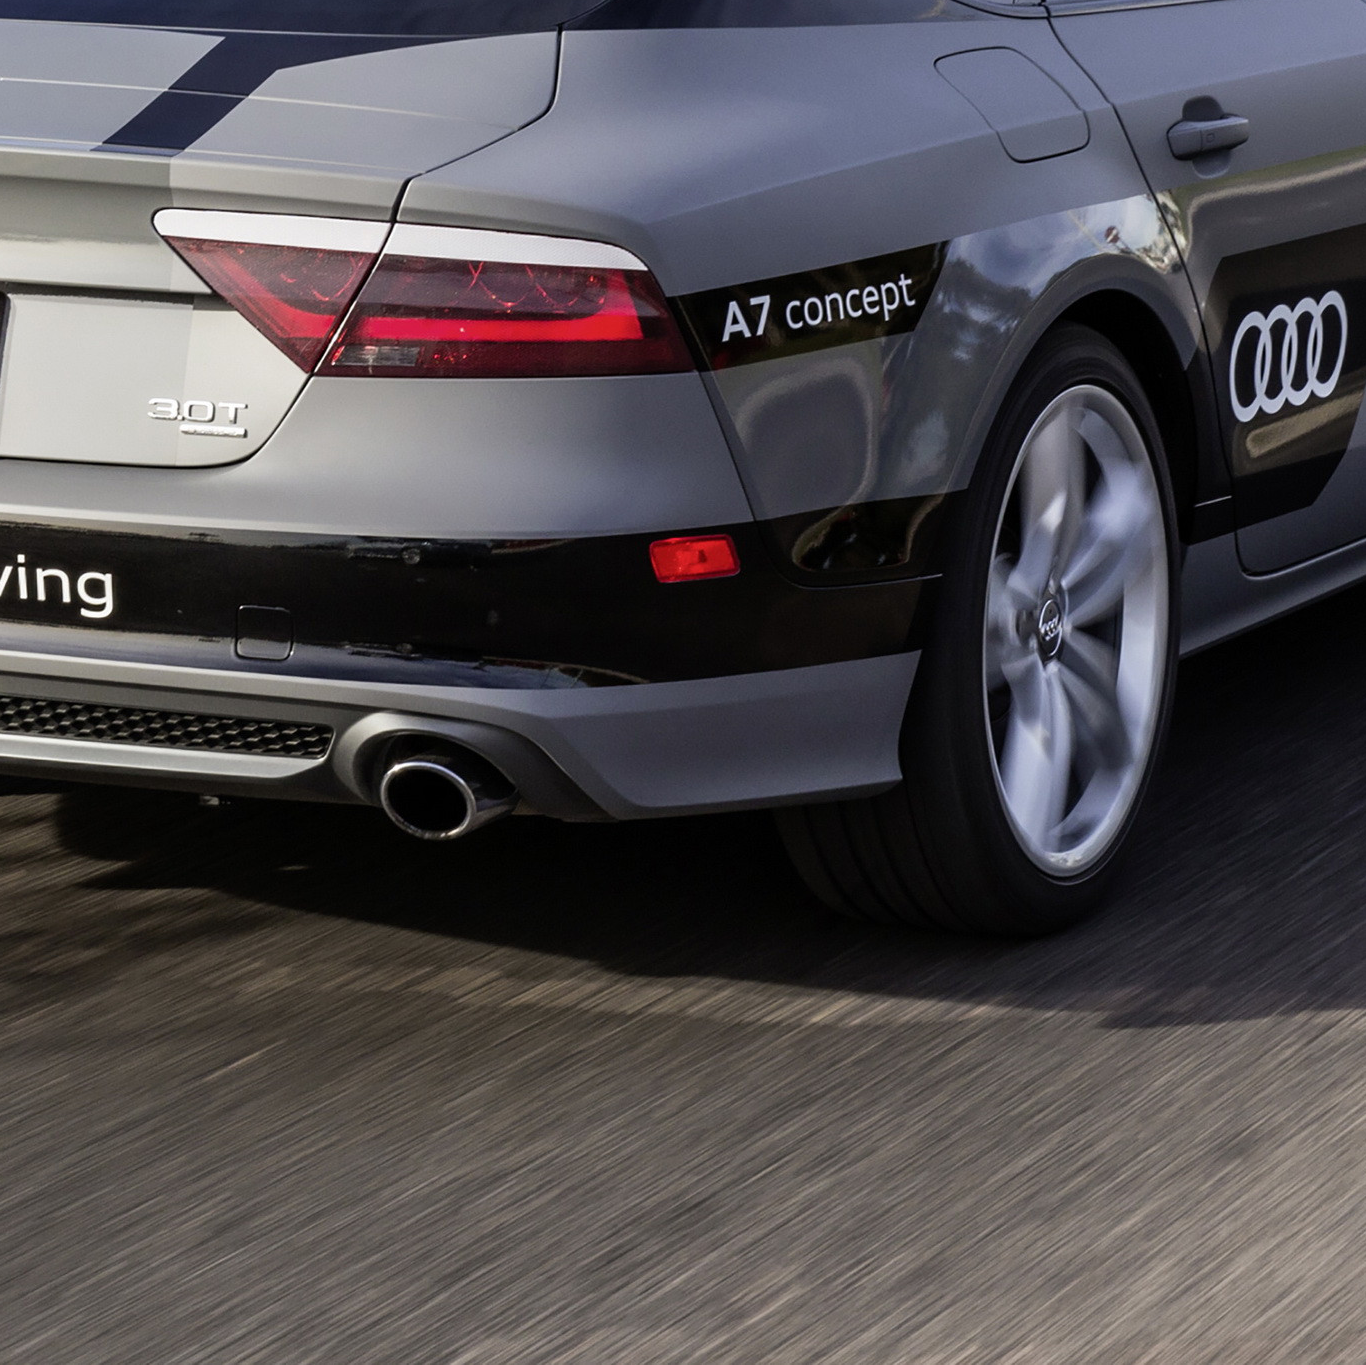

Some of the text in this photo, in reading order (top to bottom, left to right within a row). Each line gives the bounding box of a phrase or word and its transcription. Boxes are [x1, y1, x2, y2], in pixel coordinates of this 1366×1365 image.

[722, 273, 916, 343] A7 concept
[147, 397, 248, 424] 3.0T
